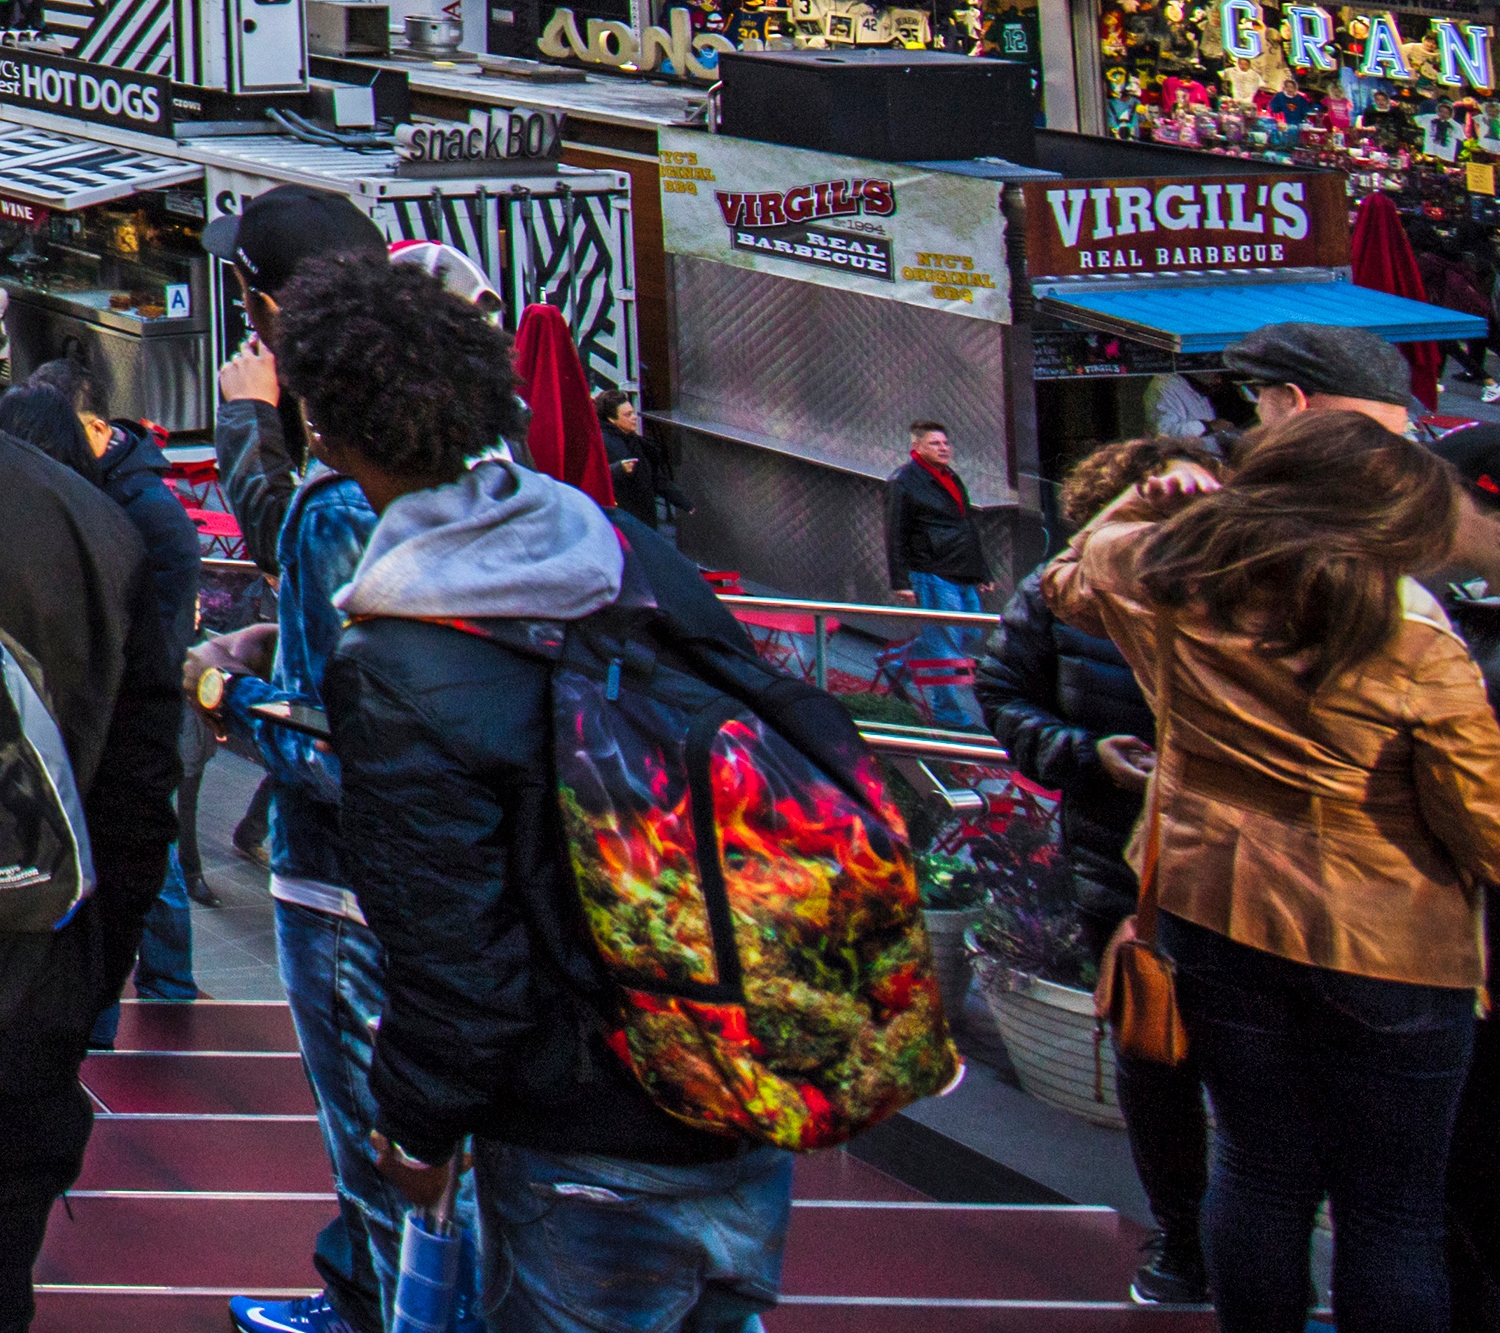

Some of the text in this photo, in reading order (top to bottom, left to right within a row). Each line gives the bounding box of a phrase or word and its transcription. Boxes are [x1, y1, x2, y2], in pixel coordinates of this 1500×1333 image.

[22, 68, 161, 126] HOT DOGS
[1047, 181, 1308, 248] VIRGIL'S
[1079, 243, 1284, 269] REAL BARBECUE
